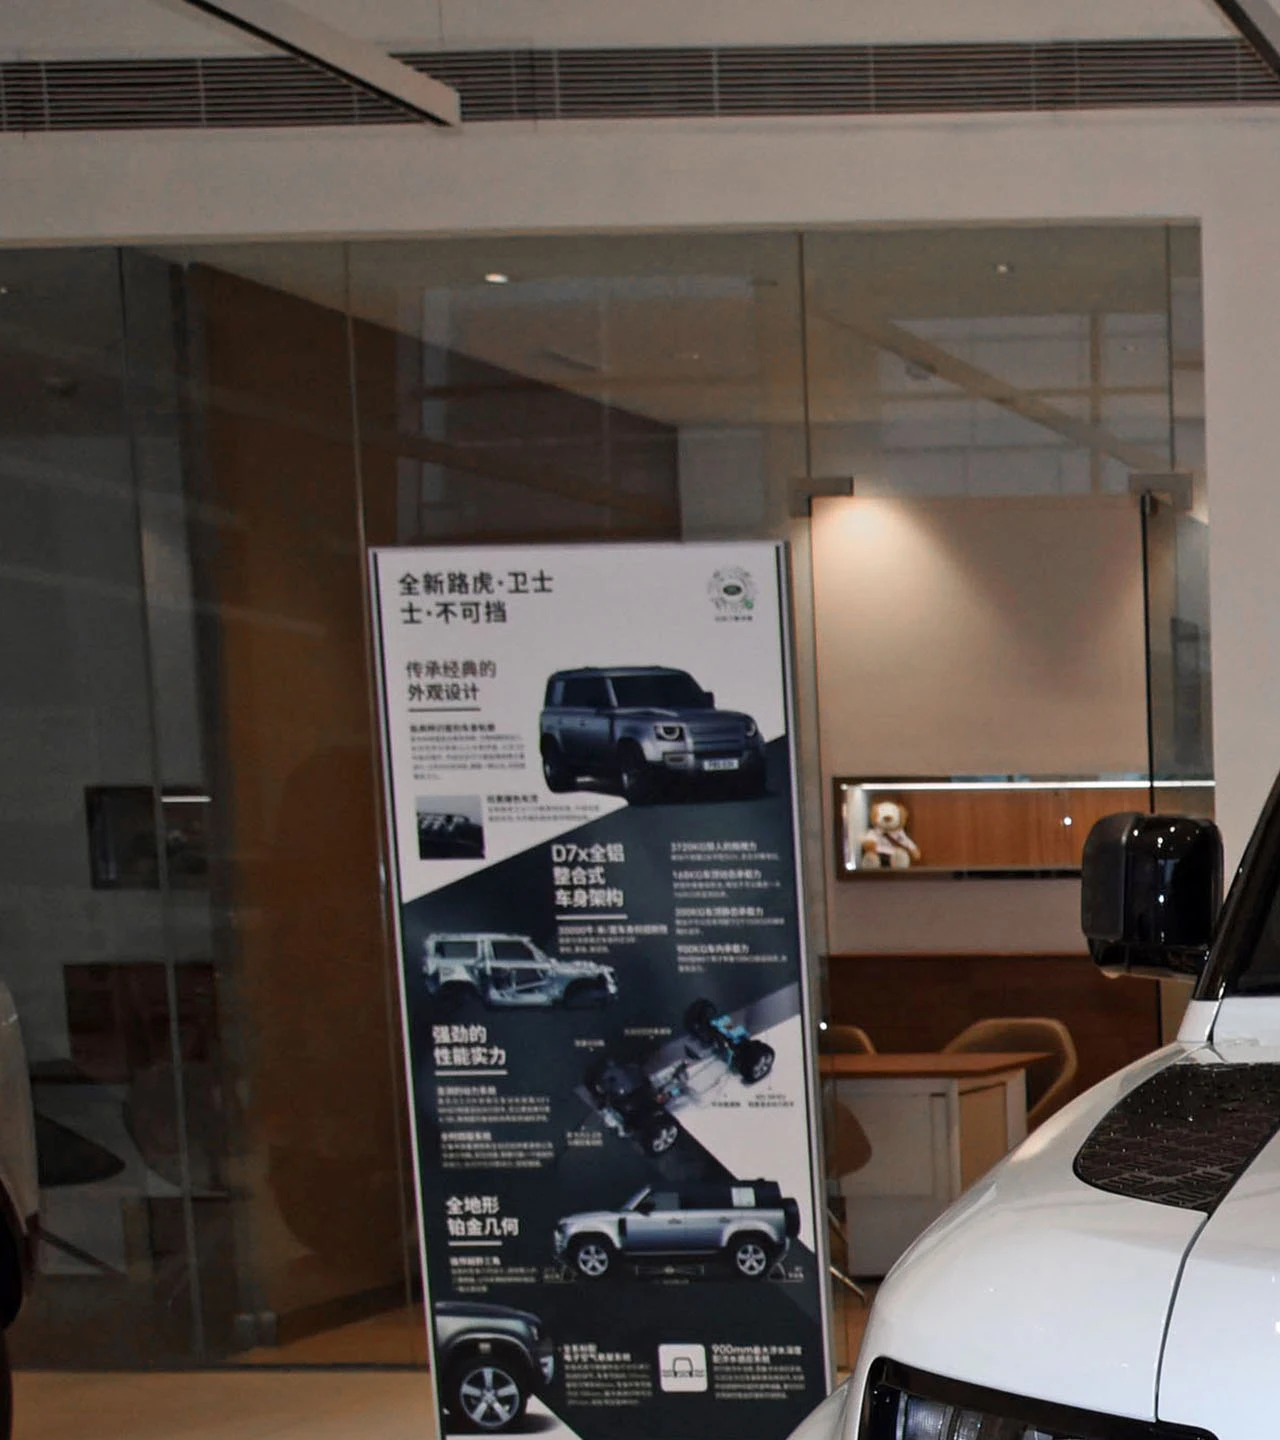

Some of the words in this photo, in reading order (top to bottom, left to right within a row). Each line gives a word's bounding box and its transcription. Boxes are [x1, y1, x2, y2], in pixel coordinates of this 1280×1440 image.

[398, 569, 553, 596] 全新路虎·卫士
[401, 600, 507, 624] 士·不可挡
[406, 660, 496, 679] 传承经典的
[408, 683, 480, 701] 外观设计
[552, 843, 624, 863] D7x全铝
[553, 866, 605, 886] 整合式
[555, 888, 624, 908] 车身架构
[432, 1024, 487, 1043] 强劲的
[434, 1045, 506, 1066] 性能实力
[446, 1196, 500, 1214] 全地形
[447, 1217, 519, 1236] 铂金几何
